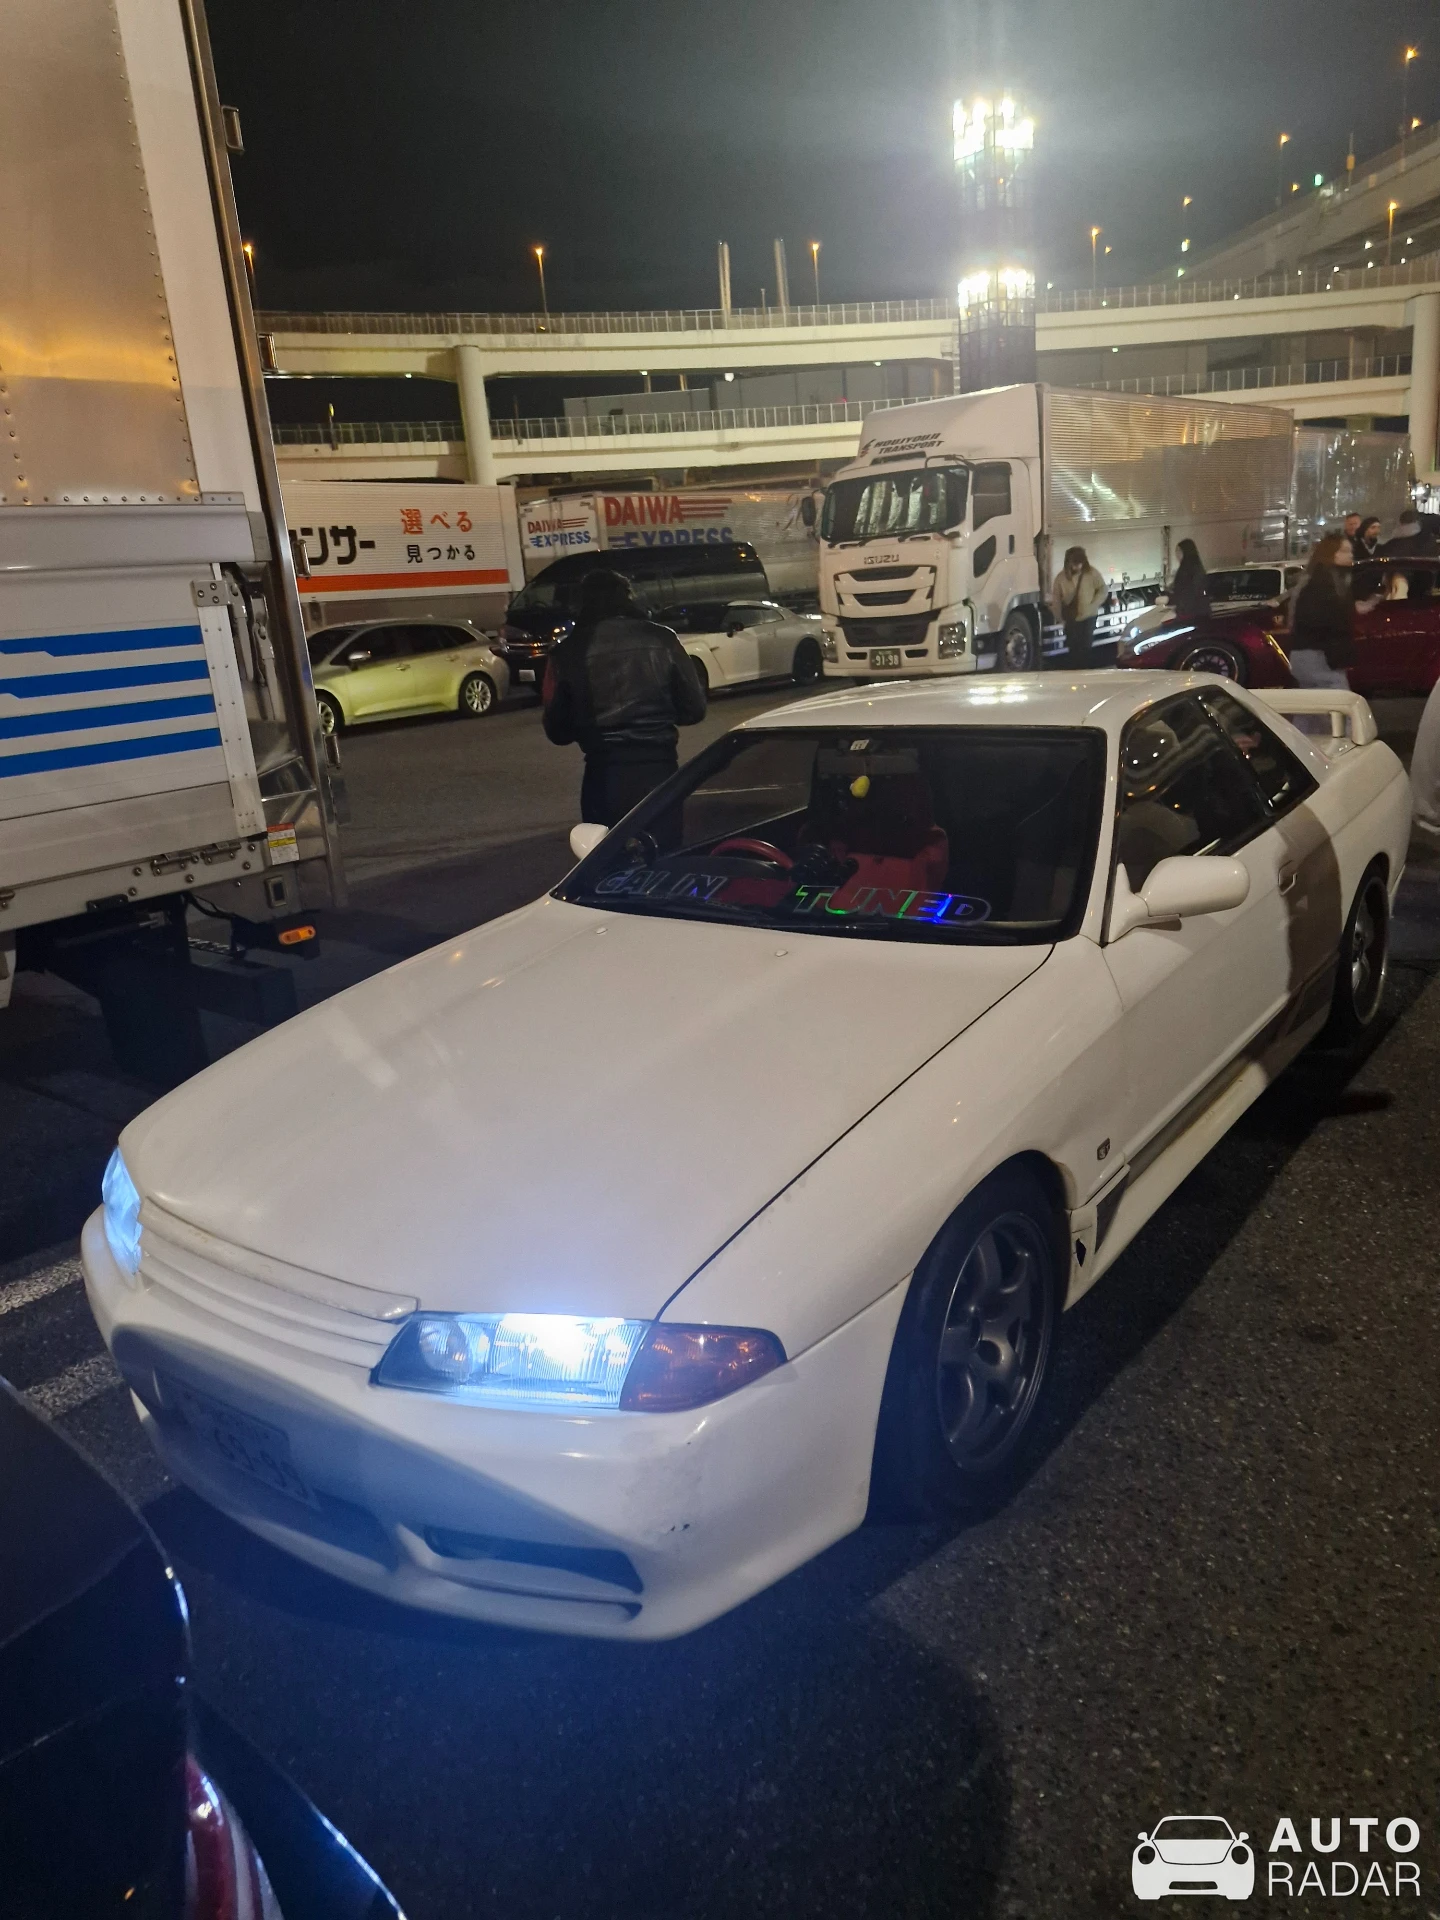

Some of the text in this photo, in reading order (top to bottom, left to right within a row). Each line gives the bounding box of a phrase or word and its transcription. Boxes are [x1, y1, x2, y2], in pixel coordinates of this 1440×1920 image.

[878, 440, 945, 455] TRANSPORT
[603, 495, 686, 527] DAIWA
[400, 508, 473, 535] 選べる
[527, 518, 563, 534] DAIWA
[531, 530, 592, 548] EXPRESS
[407, 544, 476, 564] 見つかる
[863, 554, 900, 565] ISUZU
[793, 884, 992, 926] TUNED
